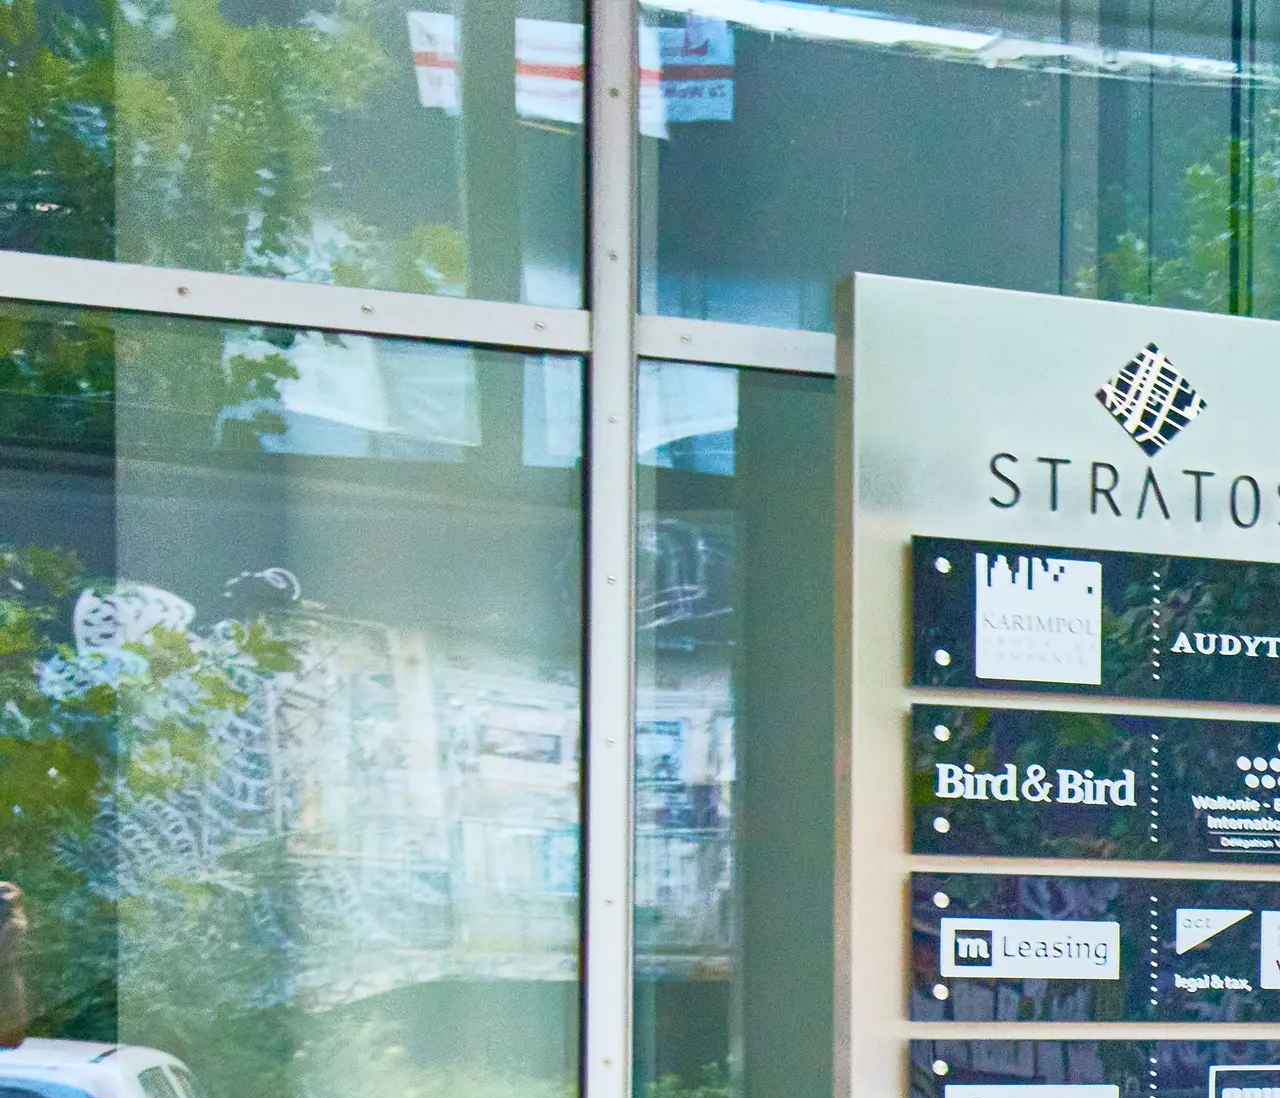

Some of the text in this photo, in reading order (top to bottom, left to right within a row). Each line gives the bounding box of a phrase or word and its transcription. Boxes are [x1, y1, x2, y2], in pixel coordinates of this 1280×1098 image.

[983, 612, 1099, 635] KARIMPOL
[935, 763, 1019, 802] Bird
[1056, 769, 1137, 806] Bird
[1191, 795, 1261, 812] Wallonie
[1003, 933, 1109, 965] Leasing
